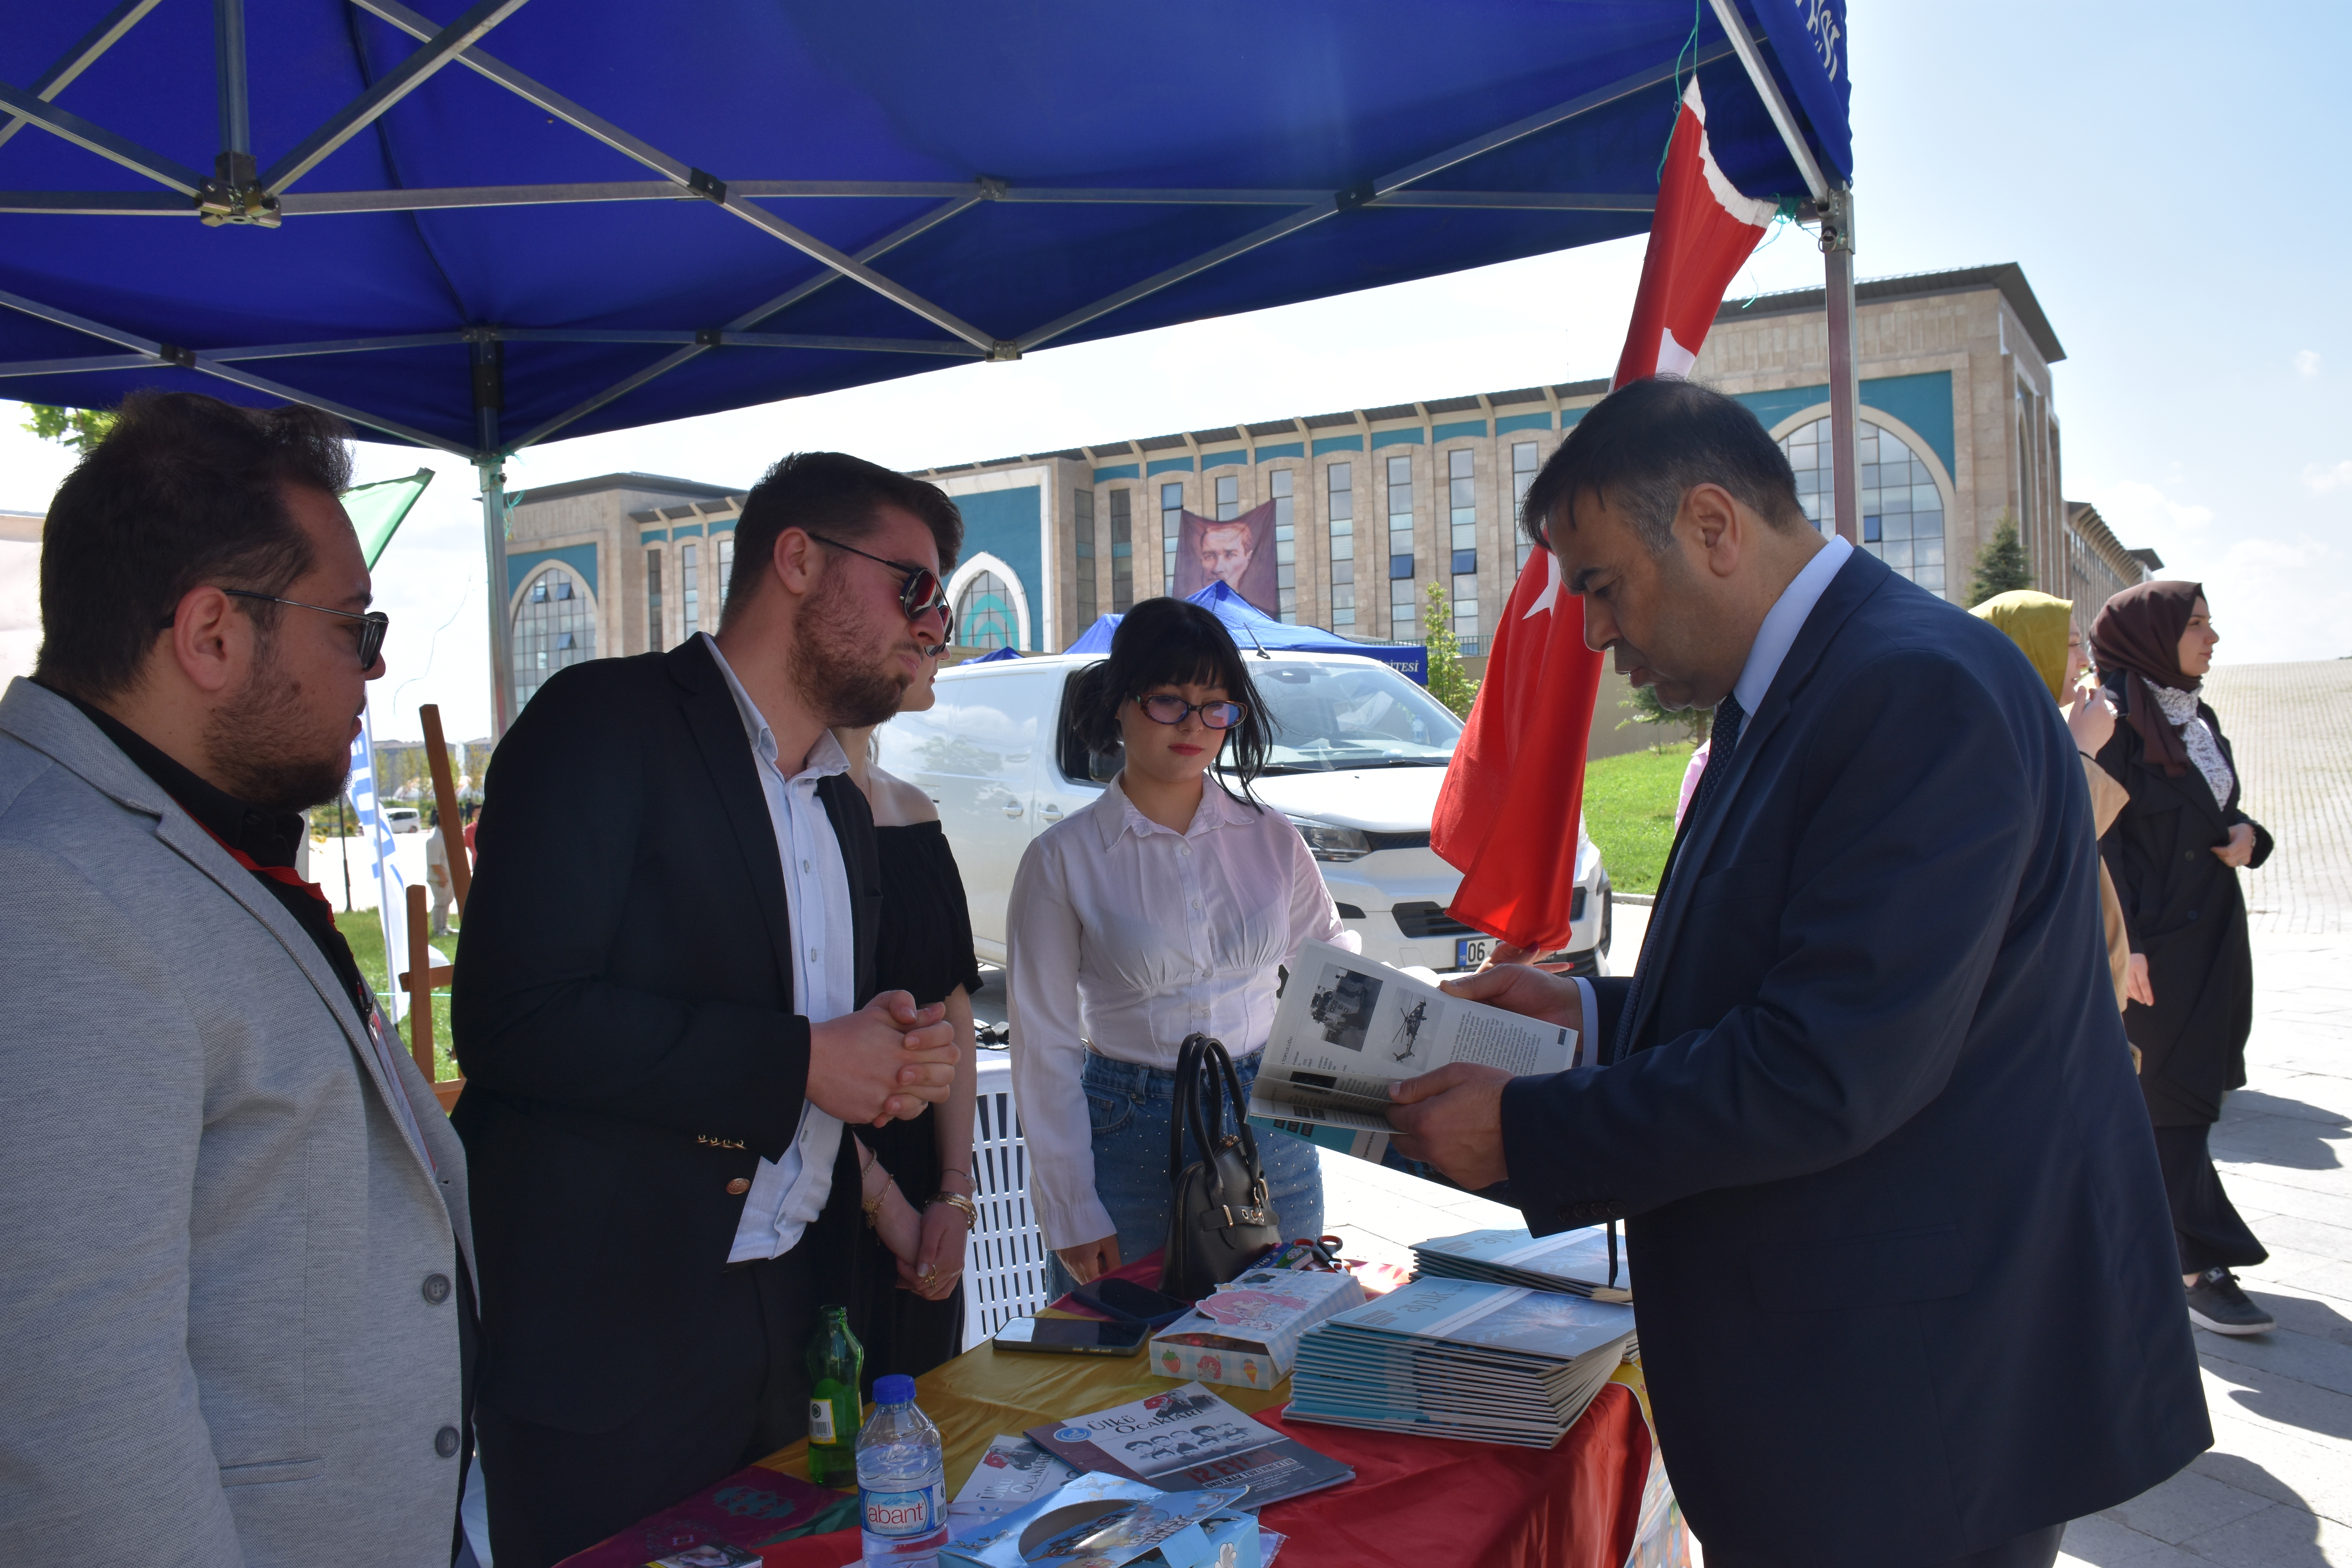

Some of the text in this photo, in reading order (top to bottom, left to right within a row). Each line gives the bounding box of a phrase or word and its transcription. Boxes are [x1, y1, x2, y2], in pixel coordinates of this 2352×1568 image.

[1467, 942, 1486, 962] 06
[1281, 1036, 1293, 1062] TOPLULUĞU
[1397, 1290, 1455, 1312] ayuk
[1187, 1465, 1218, 1486] 12
[1205, 1475, 1243, 1489] UNUTMAK
[869, 1503, 923, 1526] abant
